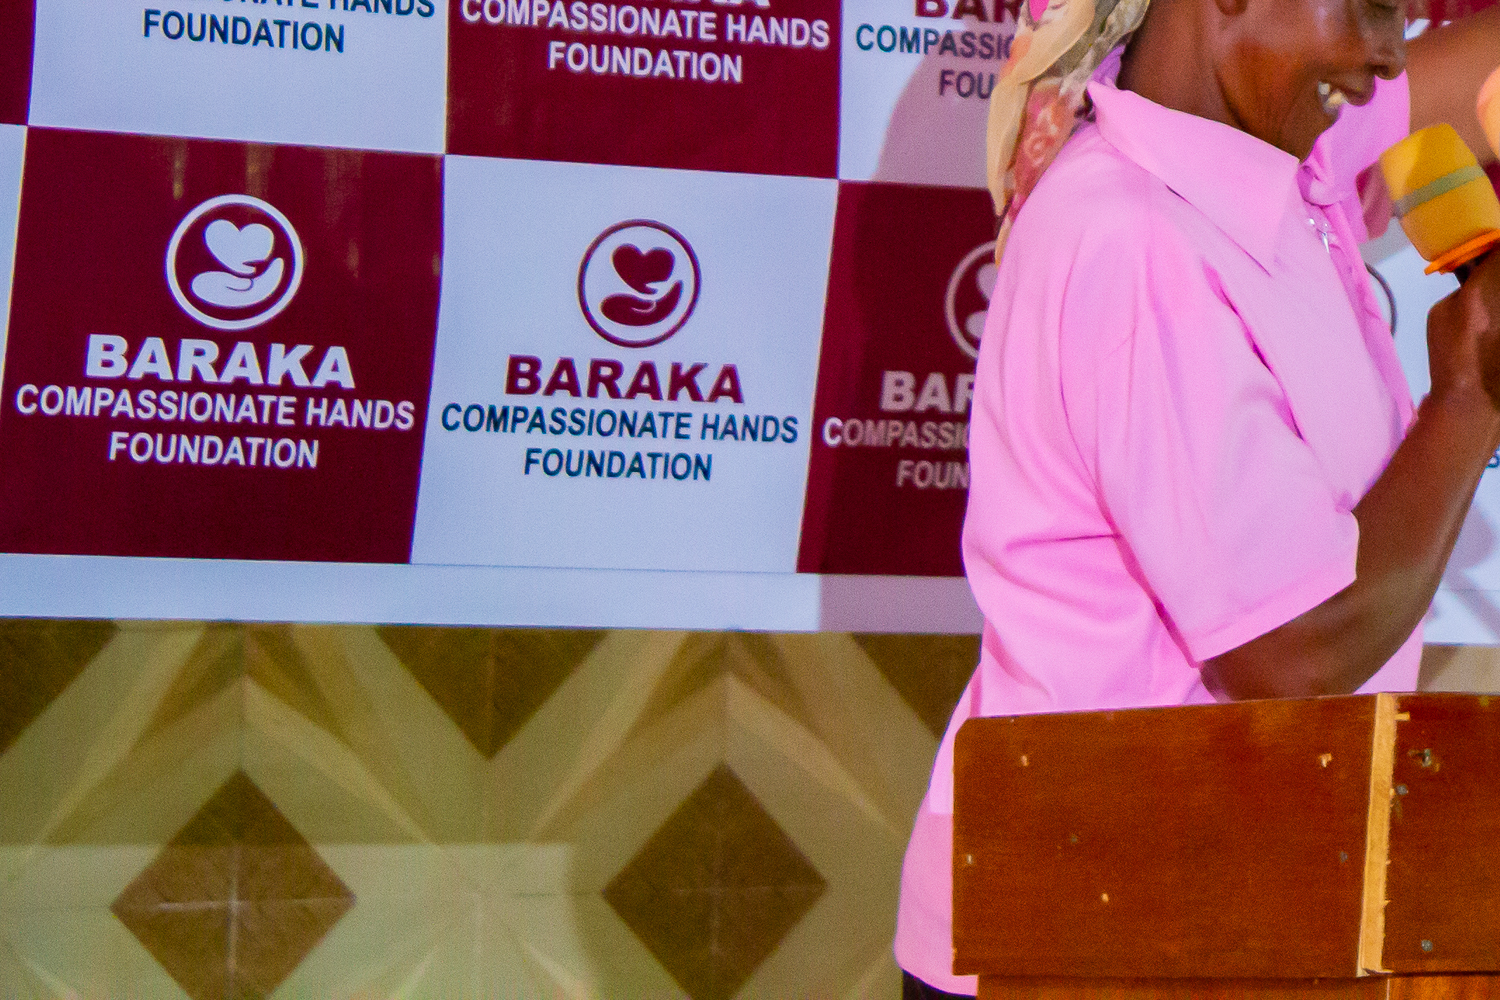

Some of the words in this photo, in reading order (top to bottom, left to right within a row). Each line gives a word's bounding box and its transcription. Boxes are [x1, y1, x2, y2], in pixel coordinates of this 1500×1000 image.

[144, 9, 344, 53] FOUNDATION
[727, 14, 830, 48] HANDS
[856, 23, 1014, 60] COMPASSI
[550, 41, 742, 82] FOUNDATION
[86, 334, 355, 388] BARAKA
[506, 355, 744, 403] BARAKA
[17, 384, 296, 425] COMPASSIONATE
[307, 398, 414, 429] HANDS
[442, 403, 692, 439] COMPASSIONATE
[701, 413, 798, 443] HANDS
[110, 432, 318, 468] FOUNDATION
[822, 417, 970, 450] COMPASSI
[525, 448, 712, 481] FOUNDATION
